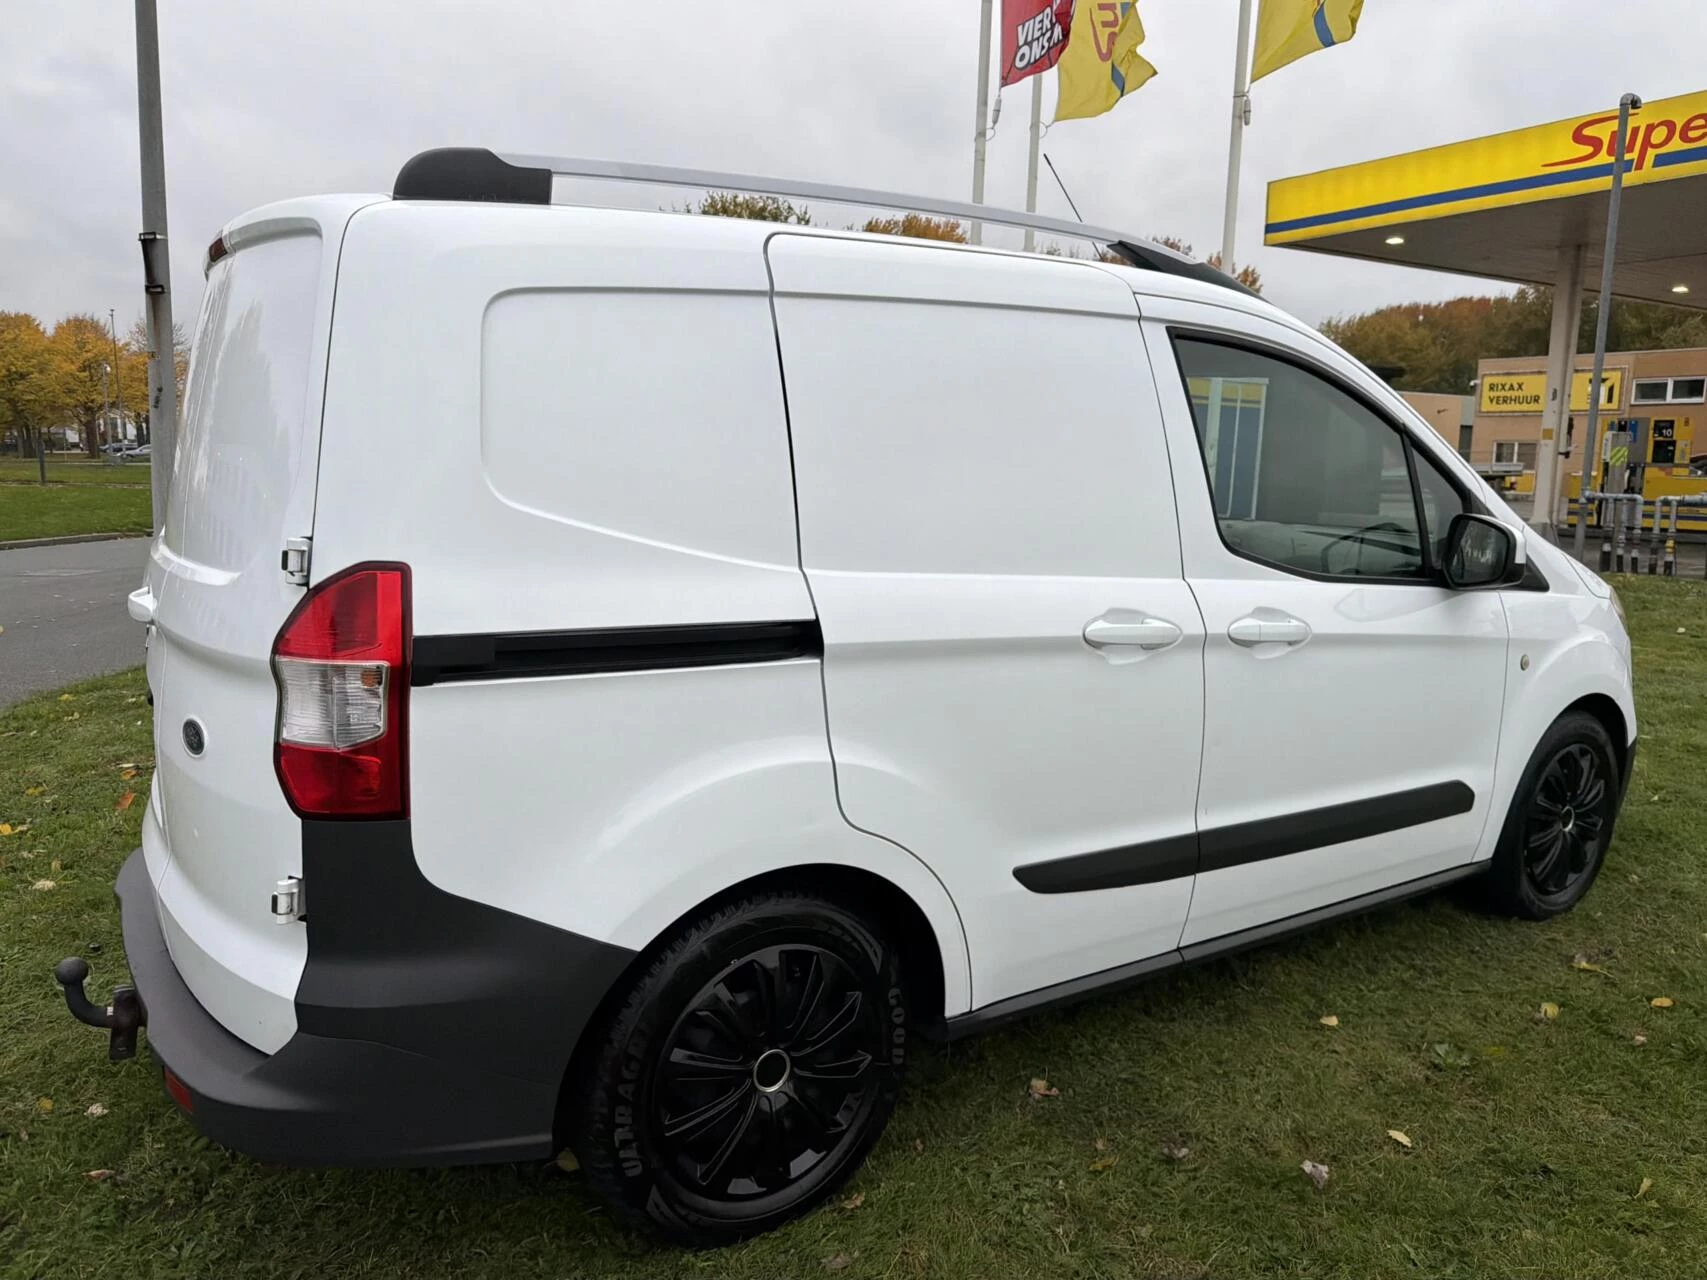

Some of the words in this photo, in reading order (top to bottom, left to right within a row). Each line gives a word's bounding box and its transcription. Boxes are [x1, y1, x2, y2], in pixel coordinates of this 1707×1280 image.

[1017, 6, 1052, 47] VIER
[1488, 382, 1524, 393] RIXAX
[1488, 394, 1541, 405] VERHUUR
[1661, 428, 1673, 438] 10
